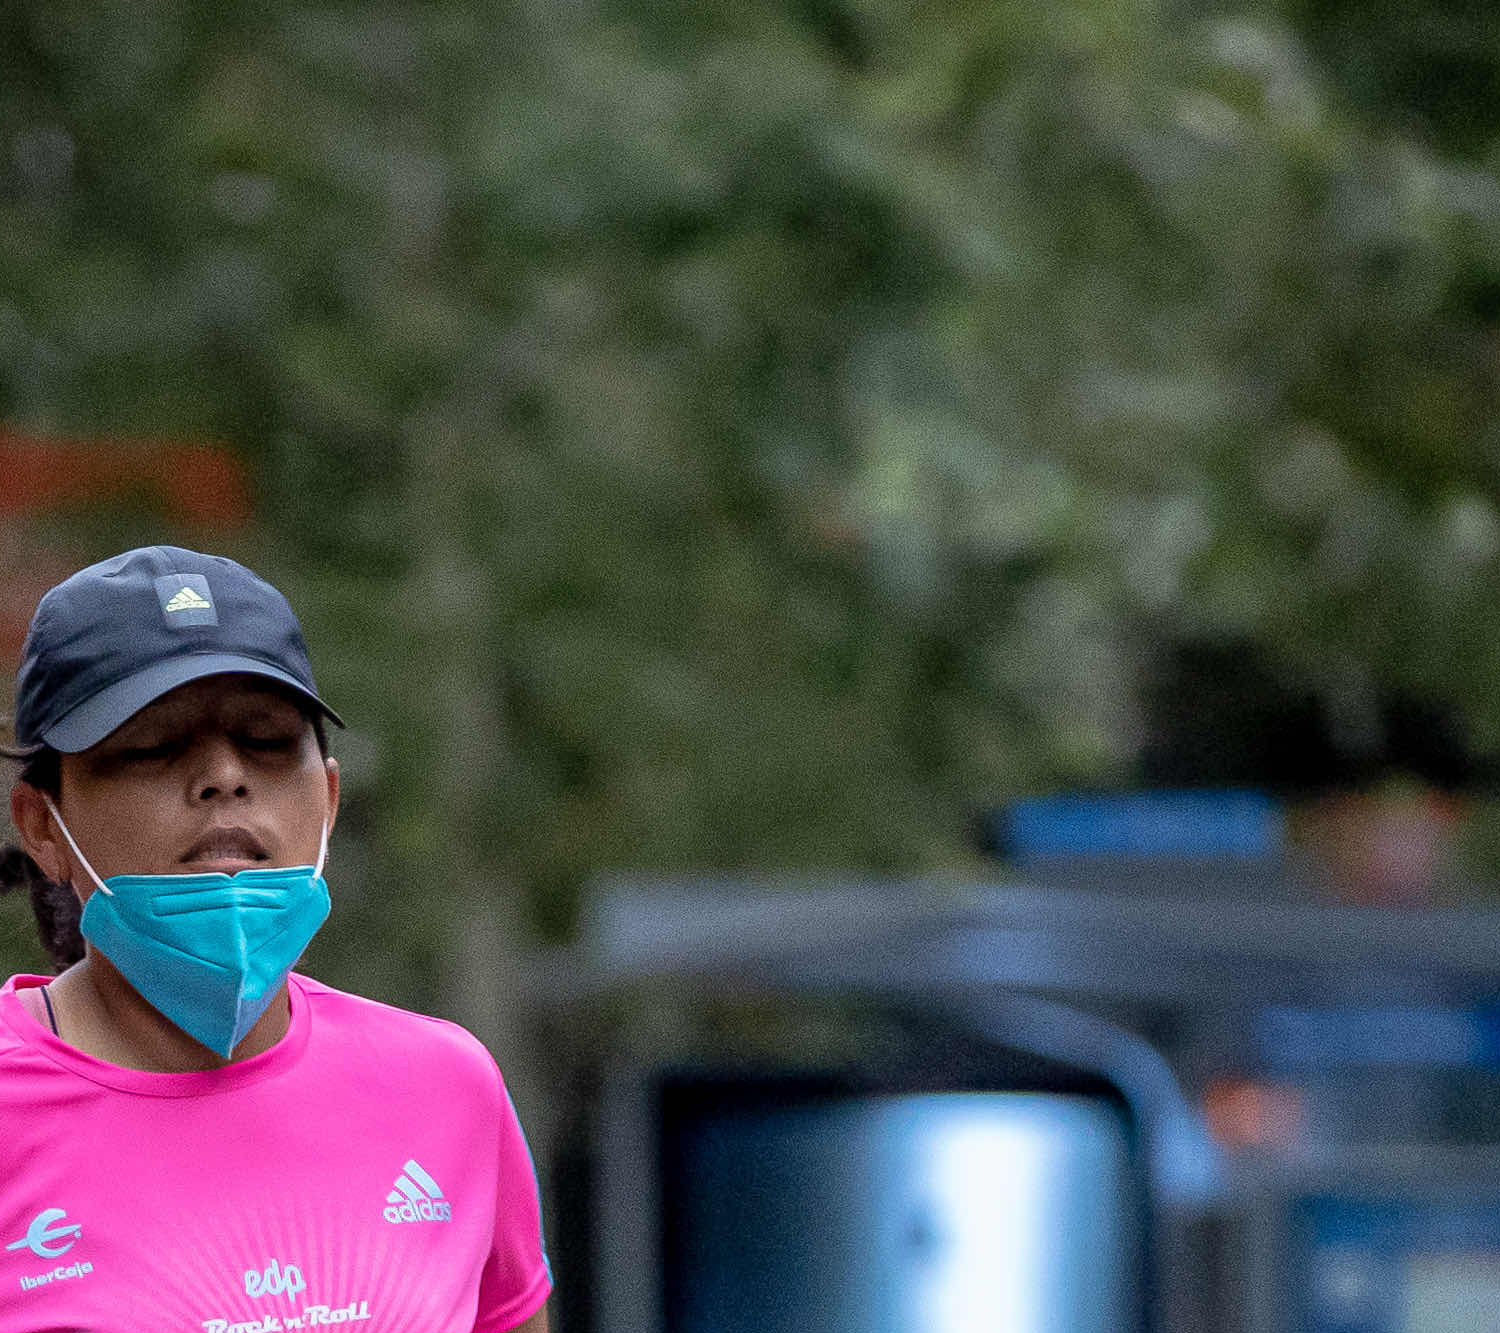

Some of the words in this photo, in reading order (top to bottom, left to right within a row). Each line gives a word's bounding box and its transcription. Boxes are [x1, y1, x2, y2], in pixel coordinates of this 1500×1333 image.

[383, 1199, 451, 1223] adidas
[244, 1258, 307, 1302] edp
[304, 1301, 371, 1326] Roll
